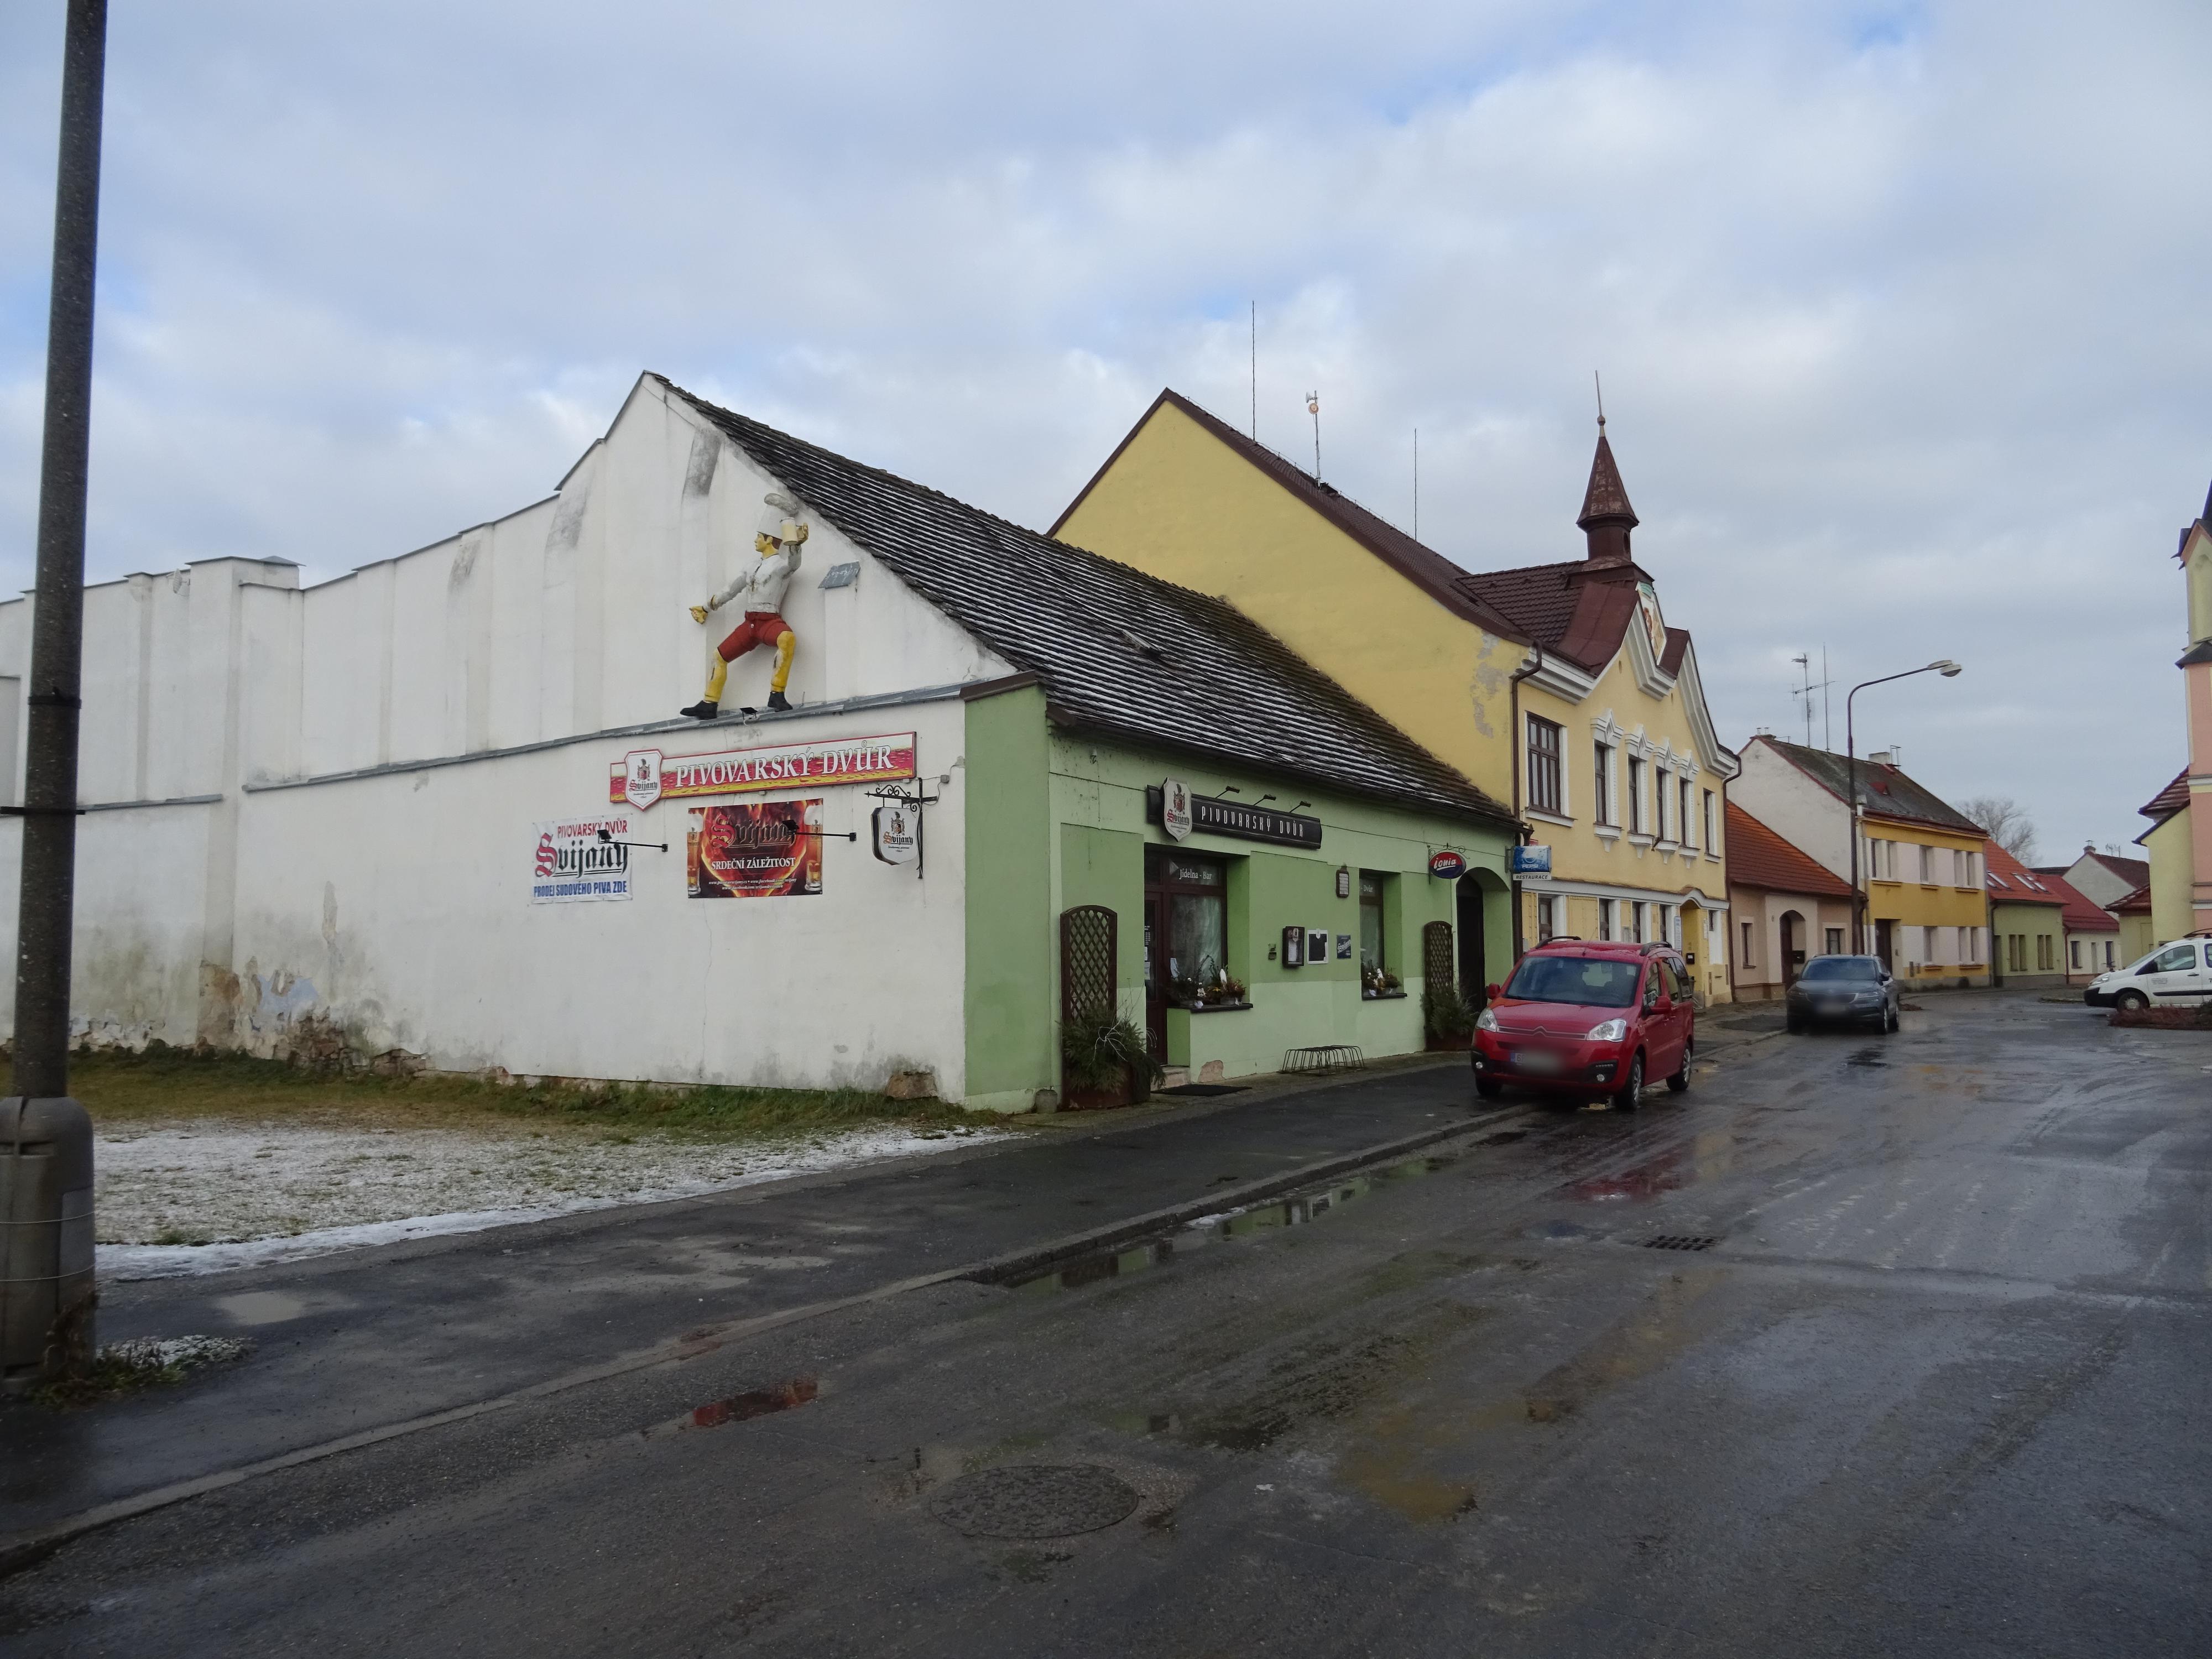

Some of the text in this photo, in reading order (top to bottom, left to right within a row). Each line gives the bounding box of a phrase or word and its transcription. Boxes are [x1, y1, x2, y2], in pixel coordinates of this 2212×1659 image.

[675, 740, 894, 787] PIVOVARSKÝ DVŮR
[629, 779, 658, 791] Svijany
[1167, 808, 1190, 826] Svijany
[1201, 806, 1303, 838] PIVOVARSKÝ DVŮR
[557, 817, 628, 838] PIVOVARSKÝ DVŮR
[883, 831, 913, 845] Svijany
[535, 832, 628, 878] Svijany
[711, 856, 796, 870] SRDEČNÍ ZÁLEŽITOST
[1179, 868, 1198, 880] Jídelna
[1203, 871, 1212, 880] Bar
[534, 880, 627, 898] PRODEJ SUDOVÉHO PIVA ZDE
